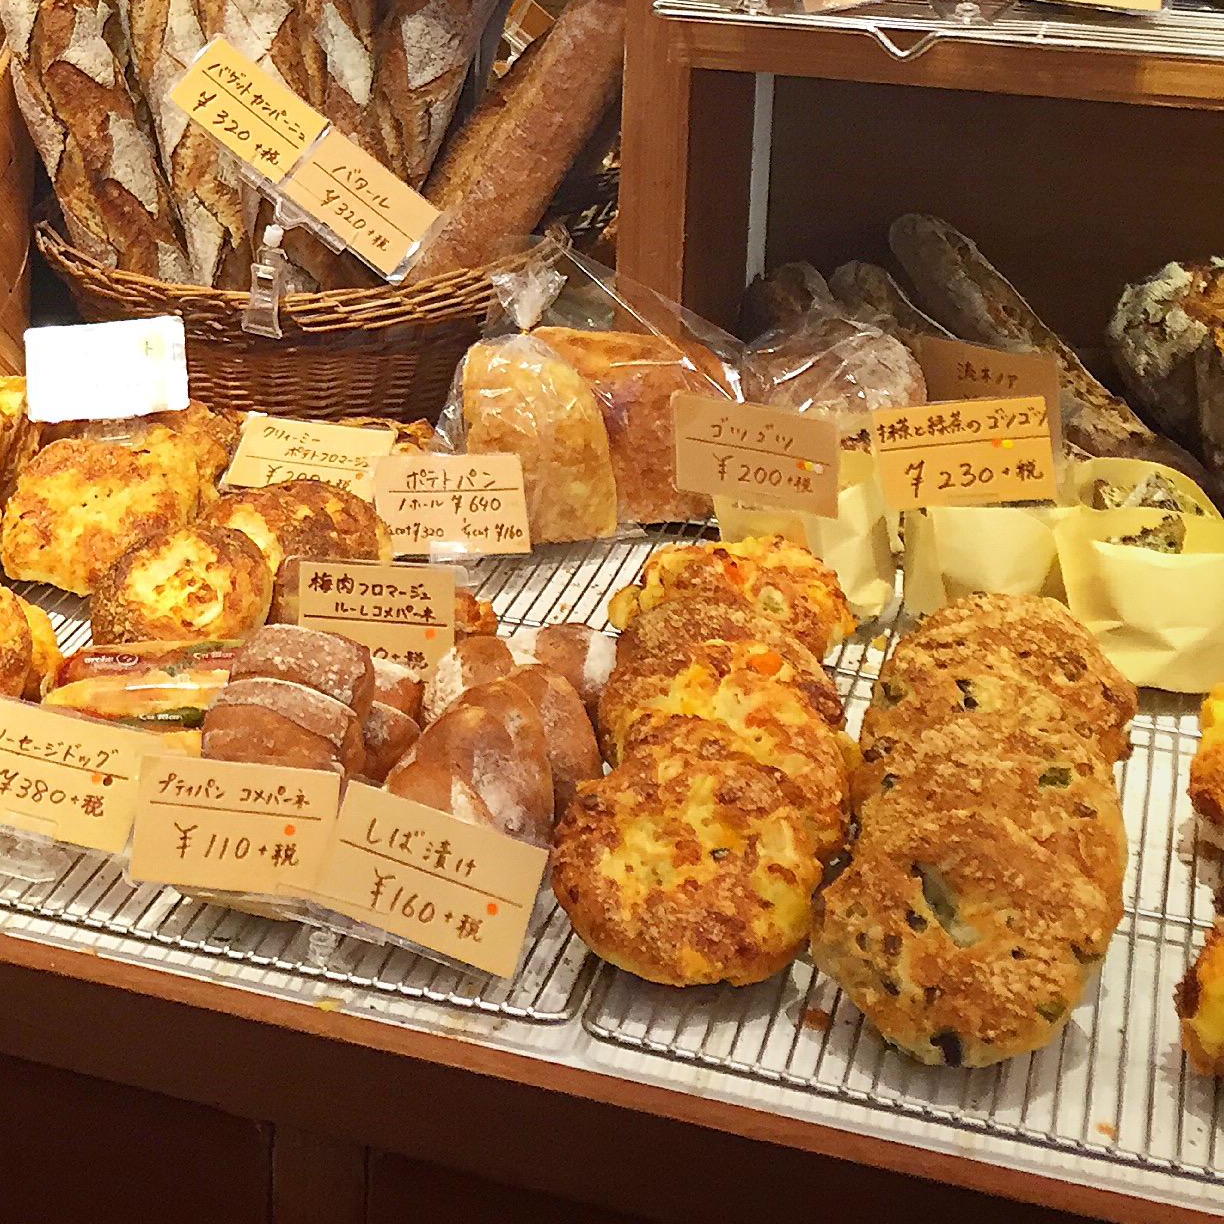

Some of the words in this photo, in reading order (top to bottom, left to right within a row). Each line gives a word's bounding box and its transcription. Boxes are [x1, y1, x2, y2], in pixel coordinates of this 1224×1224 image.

[192, 90, 279, 166] ¥320+税
[332, 164, 390, 210] バタール
[320, 187, 394, 252] ¥320+税
[712, 452, 813, 493] ¥200+税
[904, 459, 1044, 498] ¥230+税
[451, 494, 501, 515] ¥640
[0, 769, 105, 817] ¥380+税
[174, 822, 299, 868] ¥110+税
[366, 818, 477, 878] しば漬け
[370, 866, 483, 943] ¥160+税
